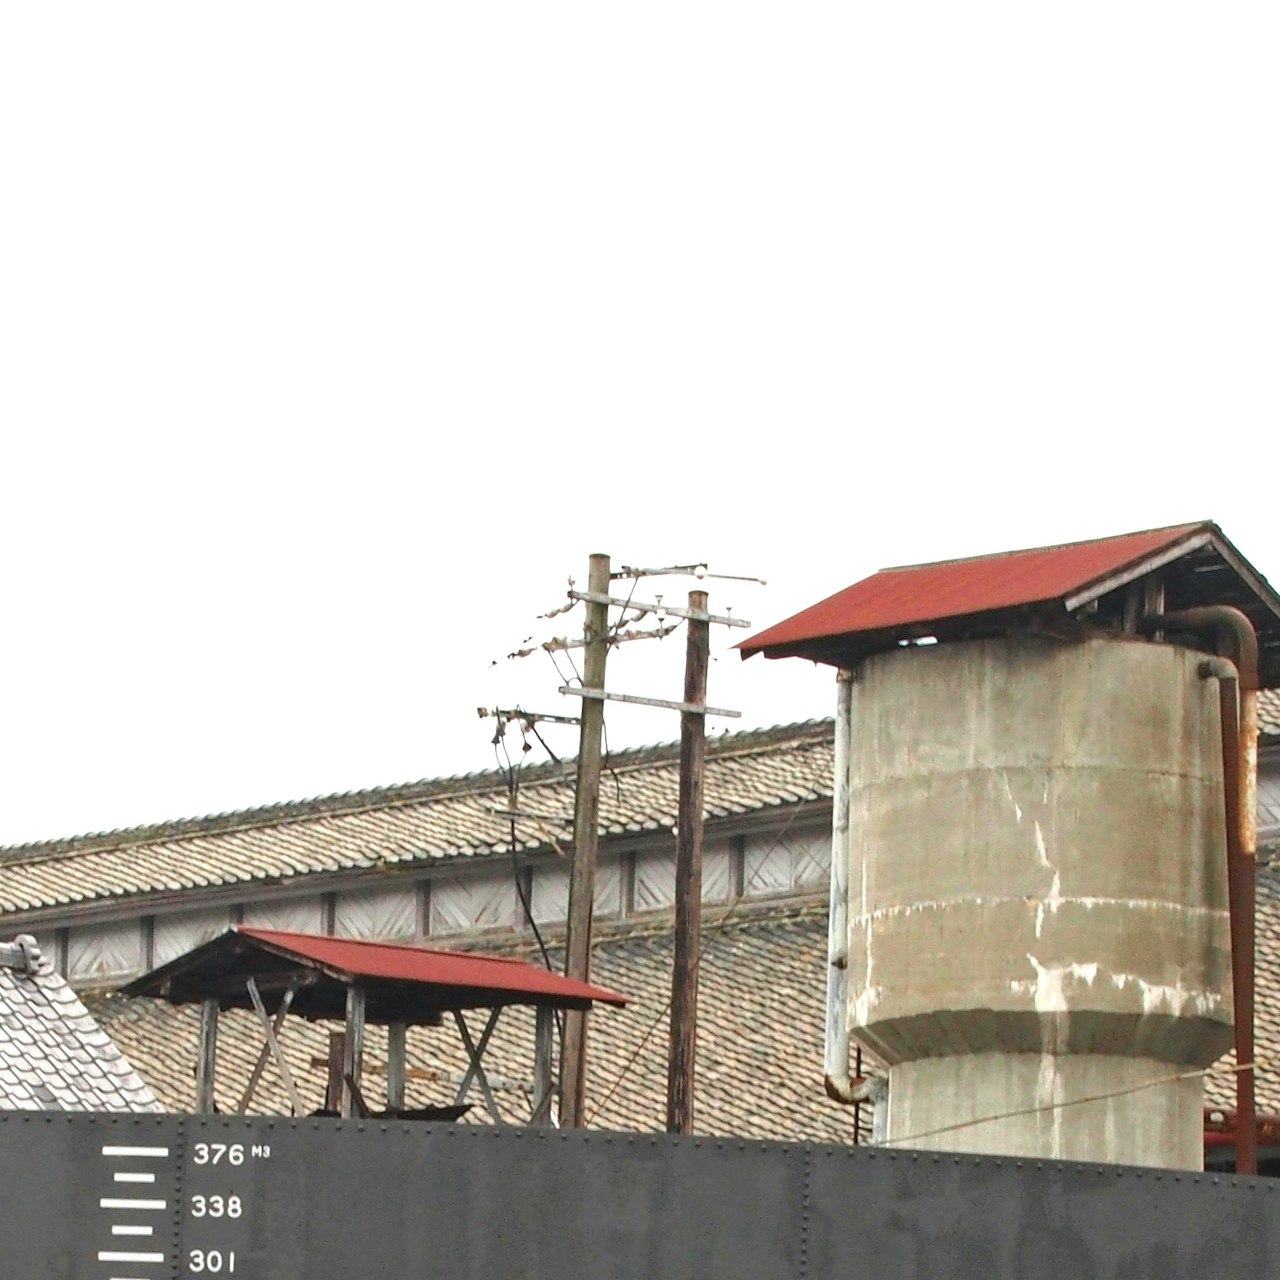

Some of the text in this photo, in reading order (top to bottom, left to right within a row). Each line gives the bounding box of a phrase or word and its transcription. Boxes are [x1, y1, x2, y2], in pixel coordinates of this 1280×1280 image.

[194, 1143, 270, 1165] 376 M3
[192, 1195, 242, 1218] 338
[190, 1250, 234, 1272] 301
